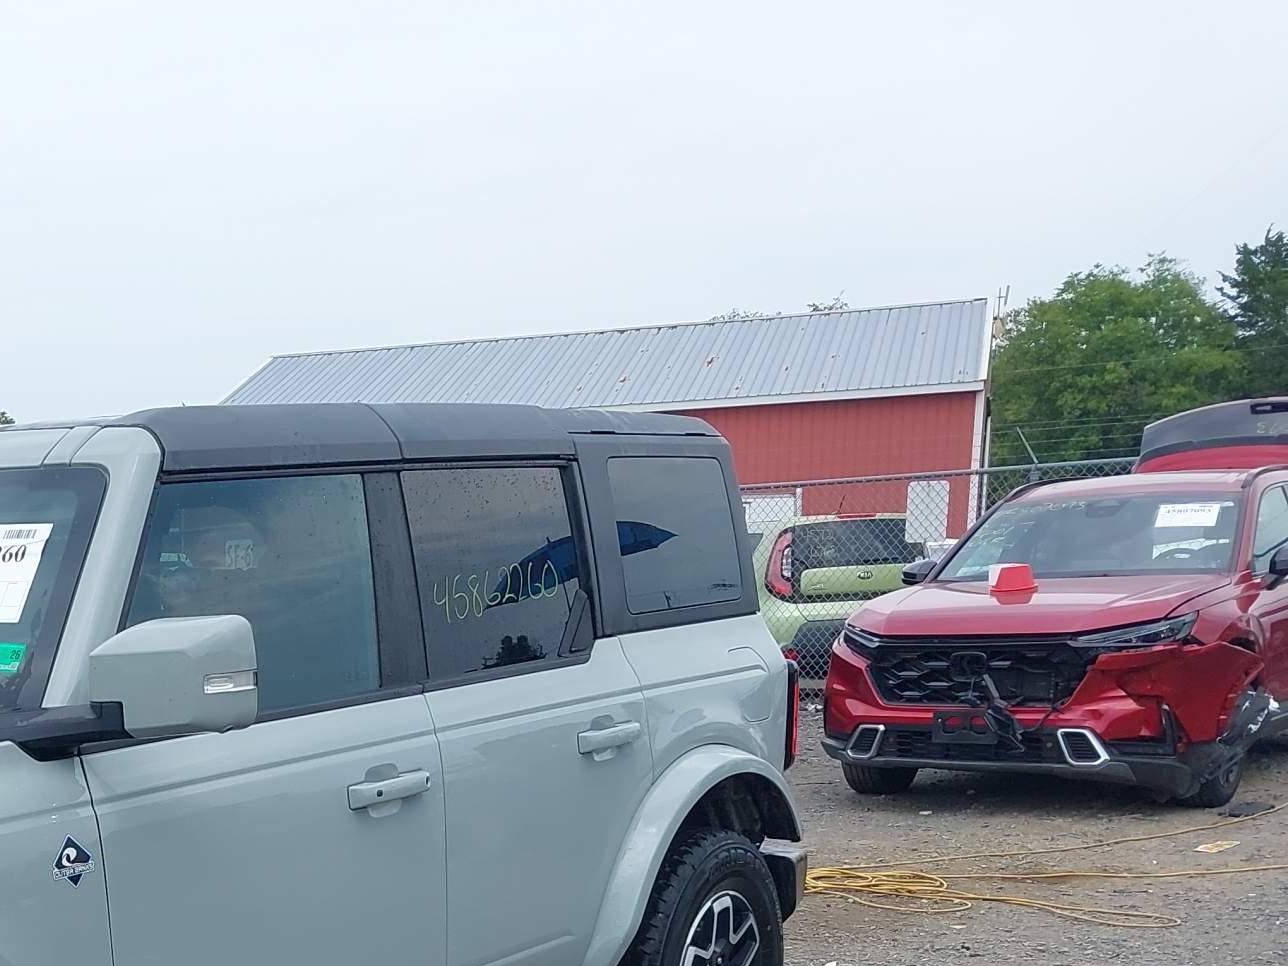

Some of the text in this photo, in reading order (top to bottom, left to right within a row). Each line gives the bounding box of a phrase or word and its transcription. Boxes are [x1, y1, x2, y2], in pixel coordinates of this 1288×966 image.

[433, 560, 559, 625] 45862260
[10, 650, 21, 660] 26
[55, 868, 74, 878] OUTER
